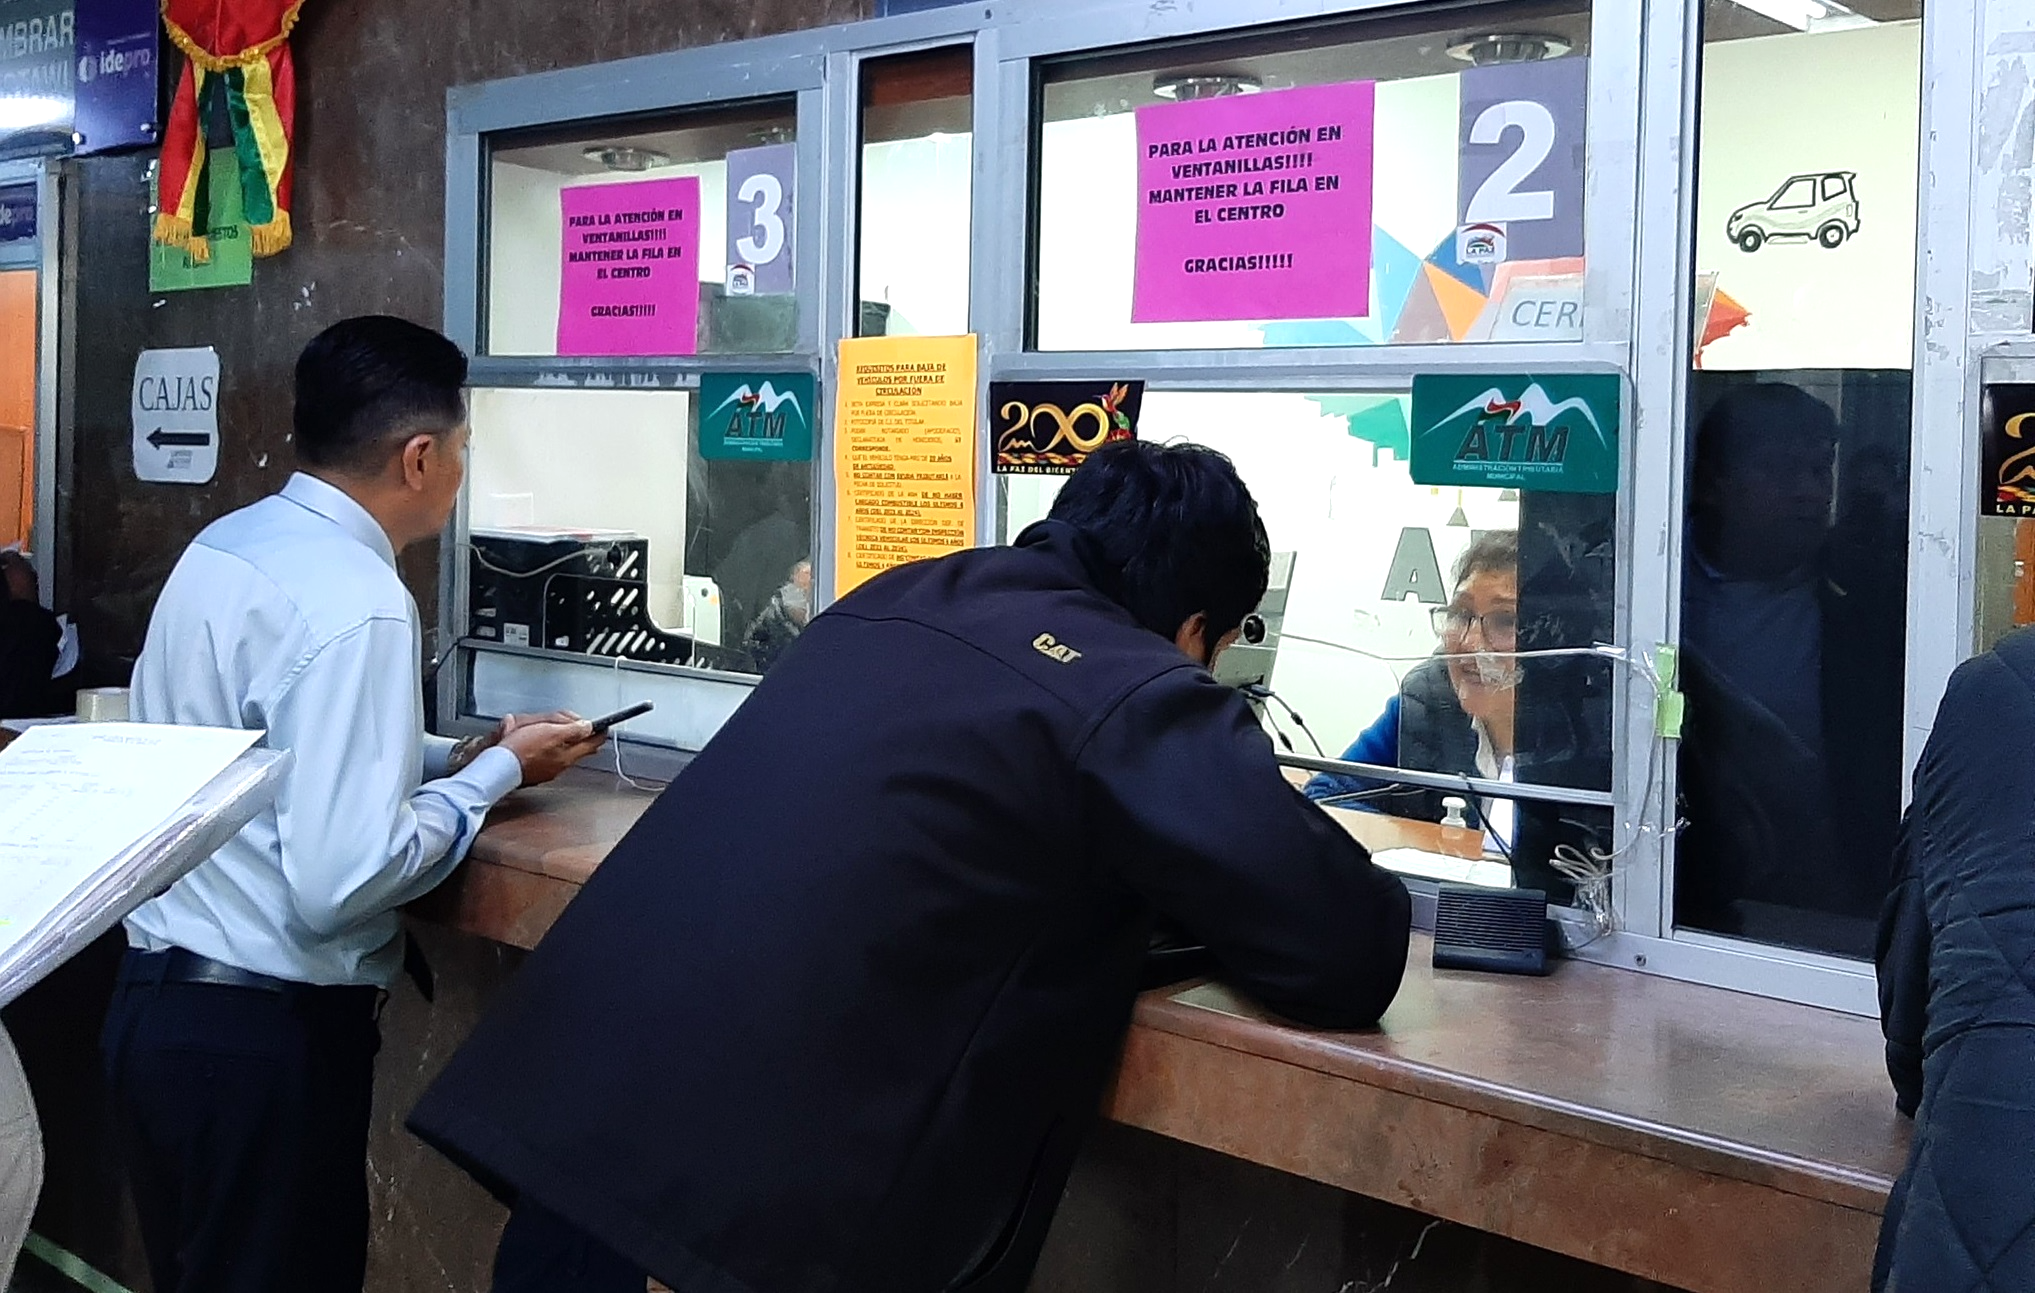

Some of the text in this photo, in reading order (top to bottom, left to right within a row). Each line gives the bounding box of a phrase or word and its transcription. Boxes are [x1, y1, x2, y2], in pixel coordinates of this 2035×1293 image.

[100, 48, 150, 77] idepro
[1148, 125, 1341, 159] PARA LA ATENCIÓN EN
[1171, 152, 1313, 180] VENTANILLAS!!!!
[1465, 100, 1555, 223] 2
[1148, 175, 1339, 205] MANTENER LA FILA EN
[569, 208, 683, 227] PARA LA ATENCIÓN EN
[736, 174, 784, 264] 3
[1194, 203, 1285, 224] EL CENTRO
[582, 228, 667, 244] VENTANILLAS!!!!
[569, 246, 681, 262] MANTENER LA FILA EN
[1184, 253, 1293, 274] GRACIAS!!!!!
[597, 266, 651, 279] EL CENTRO
[591, 304, 656, 317] GRACIAS!!!!!
[1512, 300, 1584, 329] CER
[139, 376, 213, 411] CAJAS
[725, 411, 787, 438] ATM
[998, 401, 1109, 452] 200
[1454, 424, 1570, 463] ATM
[1996, 504, 2015, 514] LA
